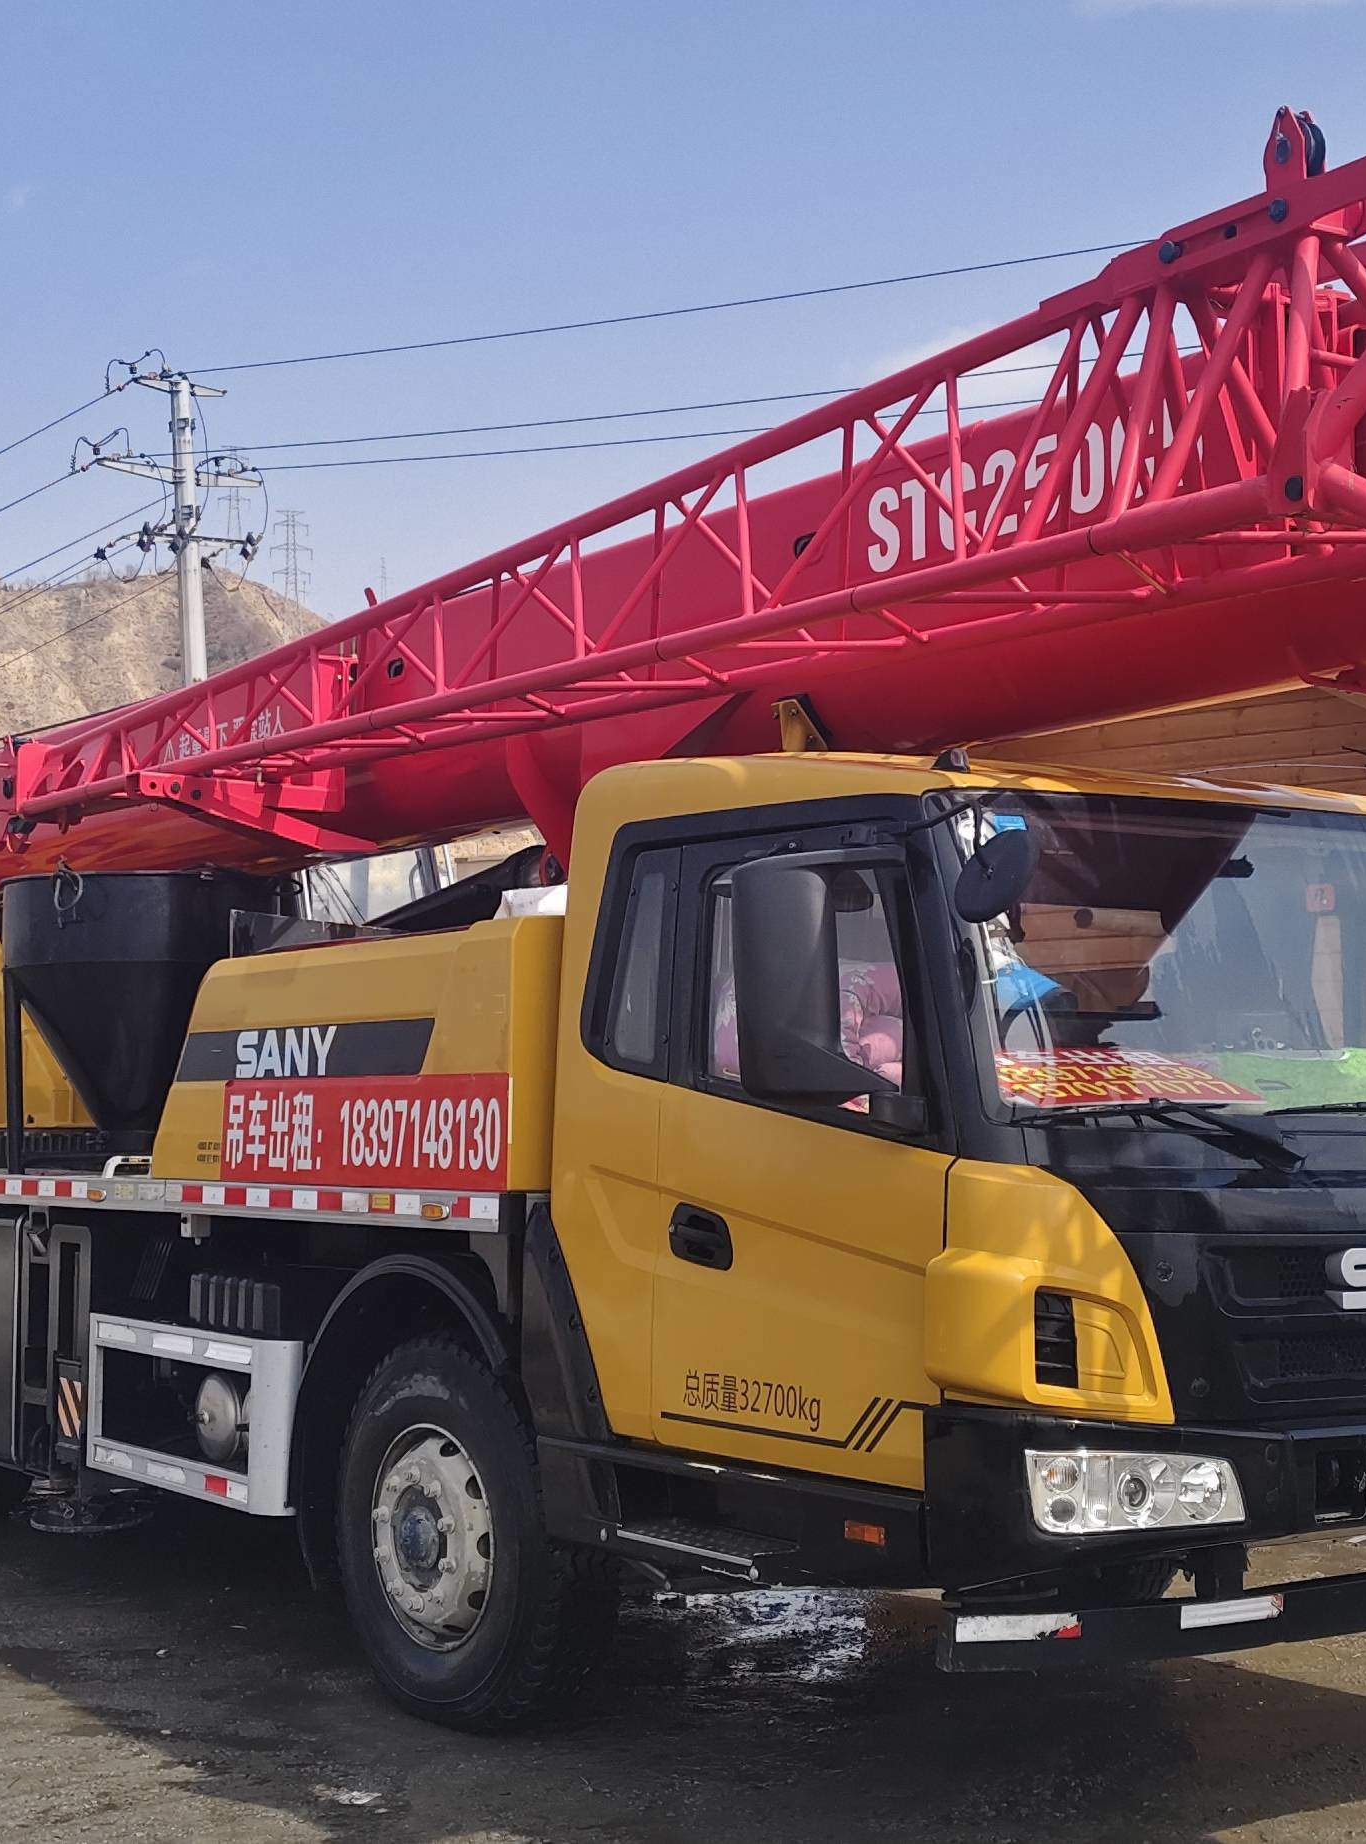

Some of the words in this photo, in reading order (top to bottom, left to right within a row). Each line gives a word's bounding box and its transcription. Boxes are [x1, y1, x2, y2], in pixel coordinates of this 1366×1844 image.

[235, 1026, 337, 1079] SANY
[339, 1097, 501, 1171] 18397148130
[683, 1368, 821, 1432] 总质量32700kg
